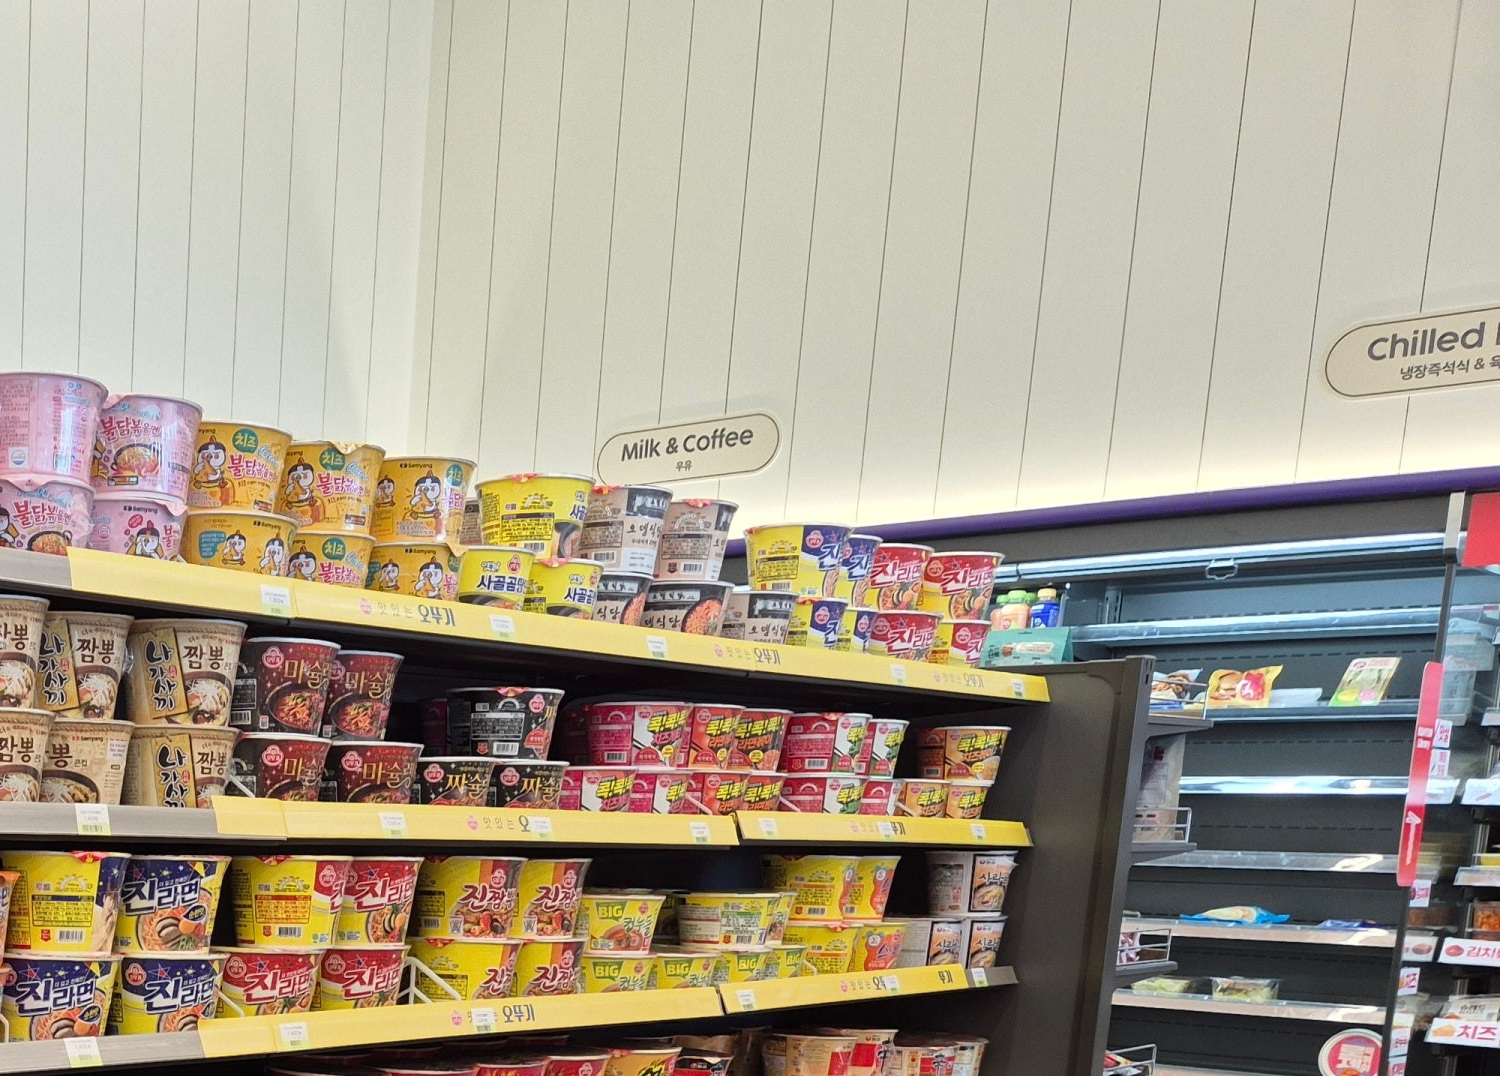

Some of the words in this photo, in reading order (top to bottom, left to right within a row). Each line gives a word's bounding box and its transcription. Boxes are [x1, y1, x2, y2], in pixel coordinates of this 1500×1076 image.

[1367, 322, 1486, 361] Chilled
[1400, 358, 1470, 381] 냉장즉석식
[1474, 357, 1485, 370] &
[101, 416, 160, 443] 불닭볶음면
[234, 433, 256, 447] 치즈
[621, 439, 661, 461] Milk
[666, 437, 678, 454] &
[683, 427, 754, 453] Coffee
[227, 454, 273, 481] 불닭볶음면
[322, 453, 344, 466] 치즈
[676, 460, 692, 472] 우유
[316, 474, 365, 496] 불닭볶음면
[325, 543, 345, 555] 치즈
[941, 566, 993, 596] 진라면
[418, 602, 456, 626] 오뚜기
[76, 638, 115, 664] 짬뽕
[182, 644, 224, 669] 짬뽕
[754, 648, 781, 665] 오뚜기
[145, 640, 177, 711] 나가사끼
[121, 876, 199, 915] 진라면
[354, 876, 416, 912] 진라면
[599, 904, 622, 918] BIG
[595, 963, 619, 978] BIG
[666, 962, 690, 976] BIG
[244, 969, 311, 1005] 진라면
[342, 966, 399, 999] 진라면
[16, 978, 93, 1017] 진라면
[145, 978, 213, 1016] 진라면
[503, 1004, 536, 1024] 오뚜기
[1457, 1024, 1497, 1040] 치즈
